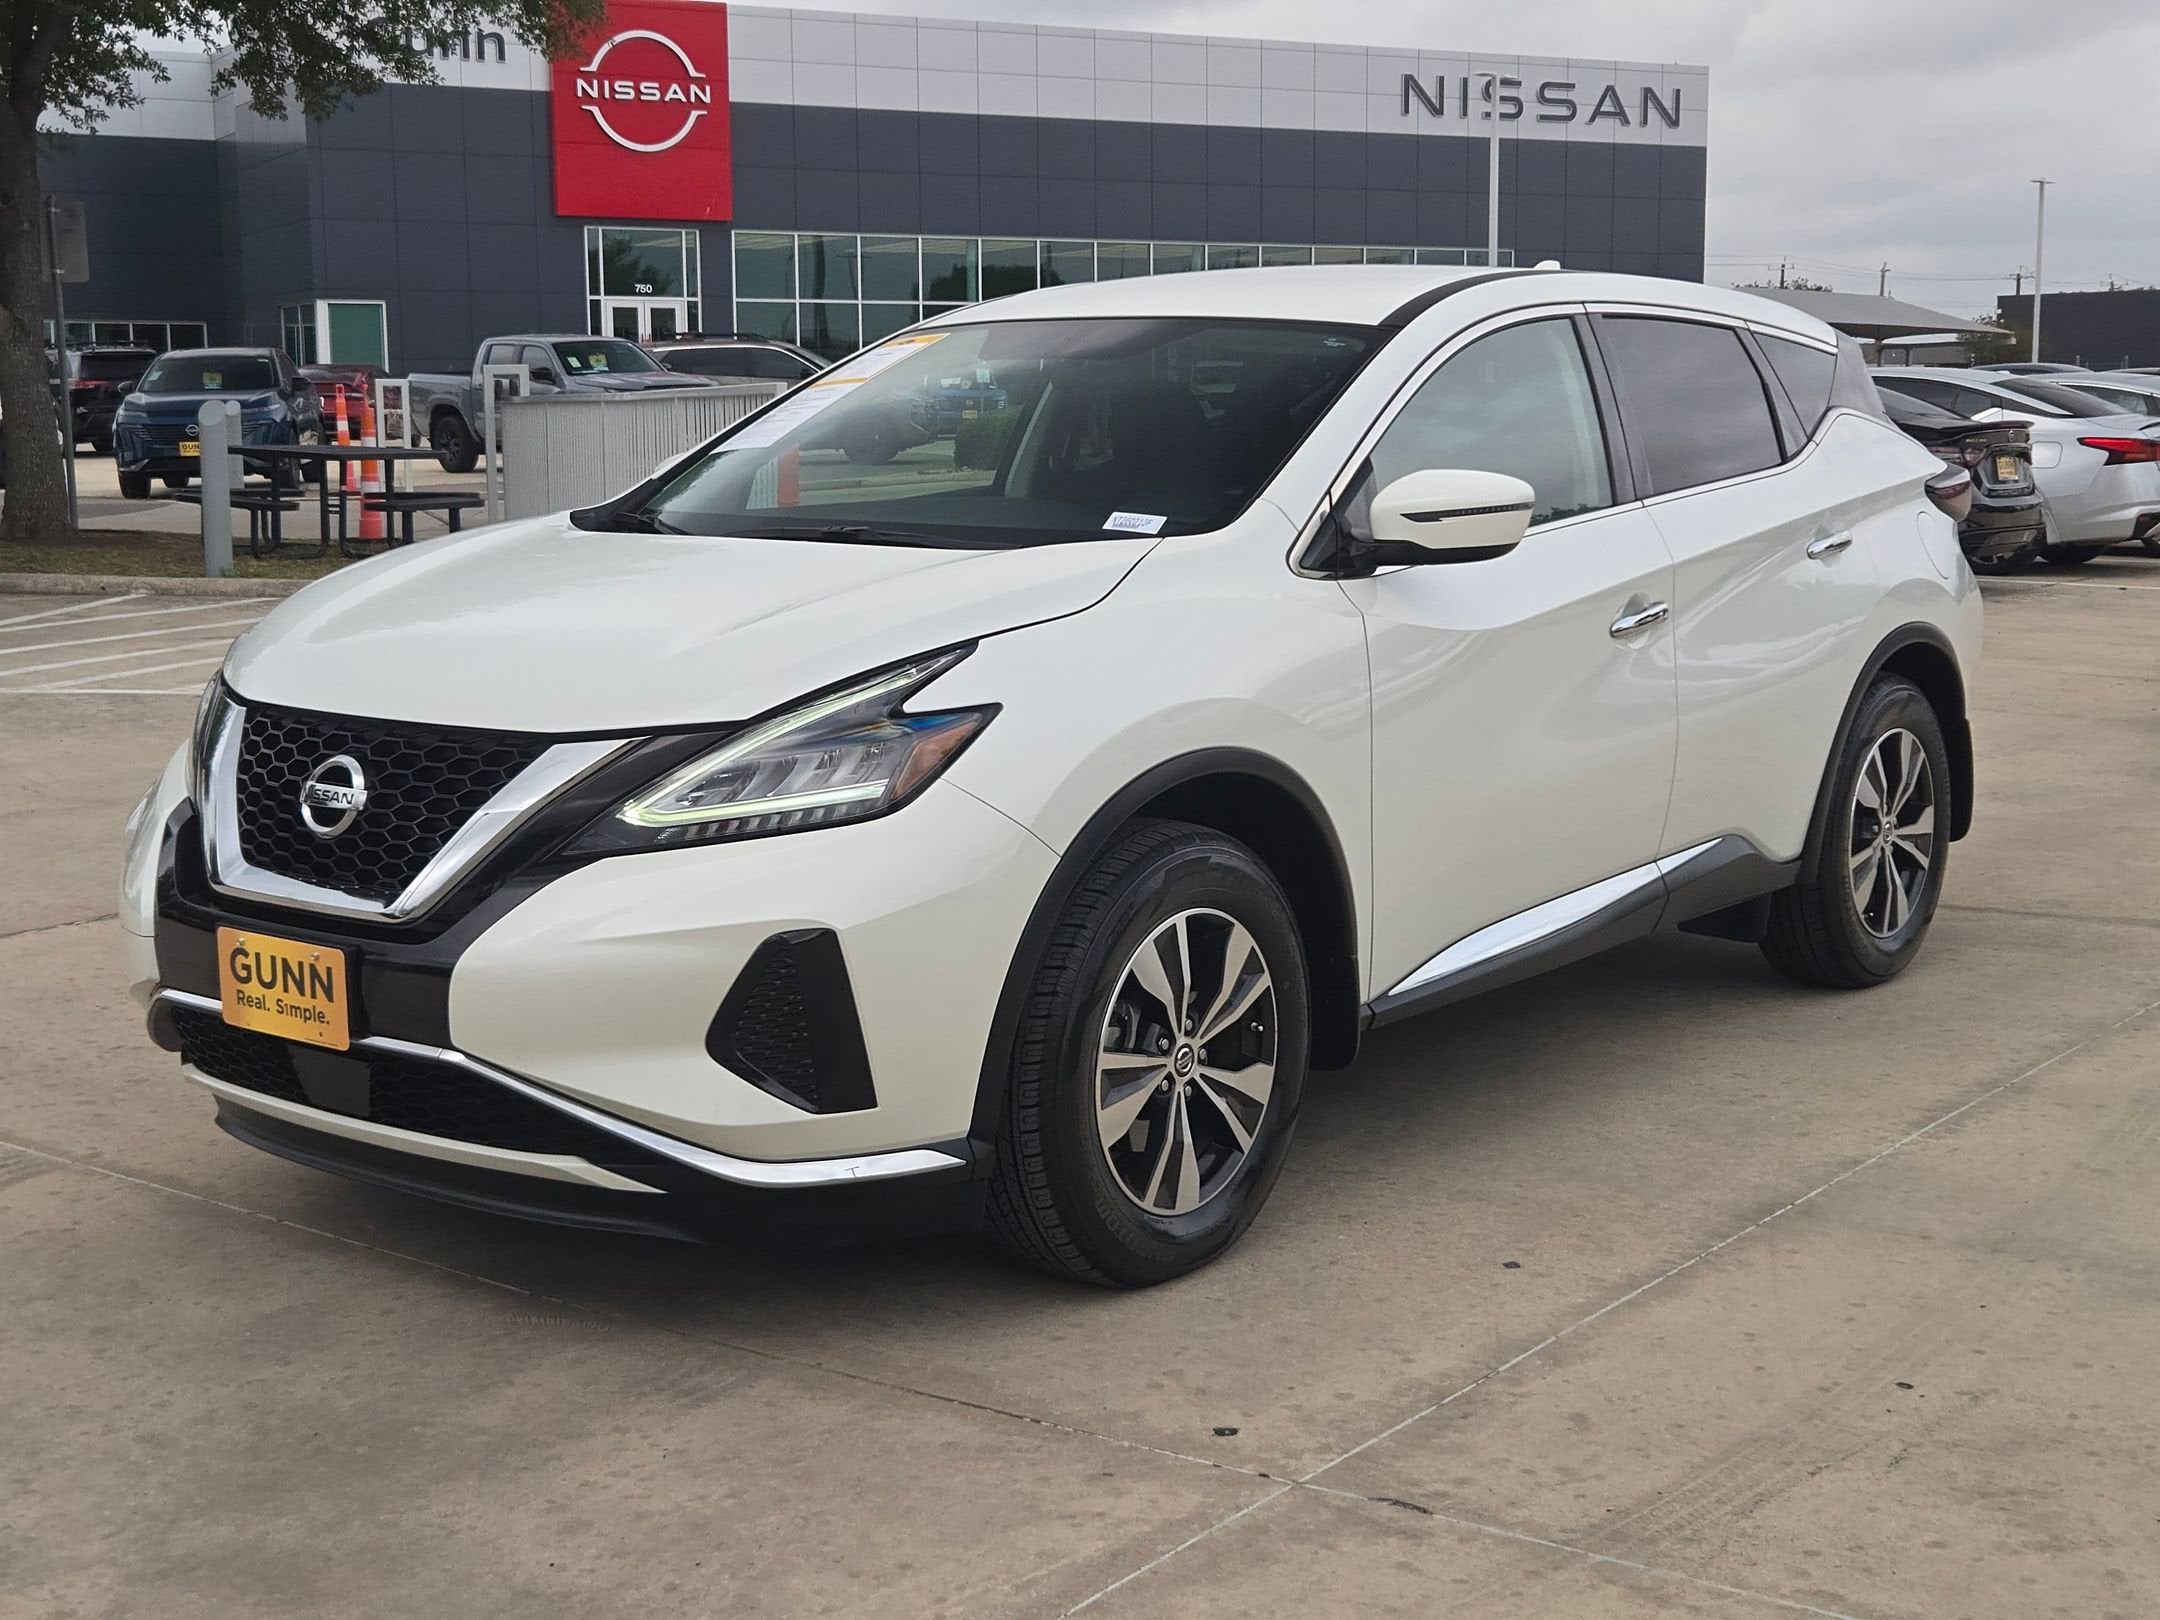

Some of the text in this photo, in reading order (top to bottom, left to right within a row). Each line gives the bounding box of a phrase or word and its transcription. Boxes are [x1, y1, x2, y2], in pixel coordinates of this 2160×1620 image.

[576, 78, 711, 104] NISSAN
[1401, 73, 1681, 129] NISSAN
[634, 283, 653, 294] 750
[230, 946, 334, 1003] GUNN
[236, 989, 271, 1012] Real.
